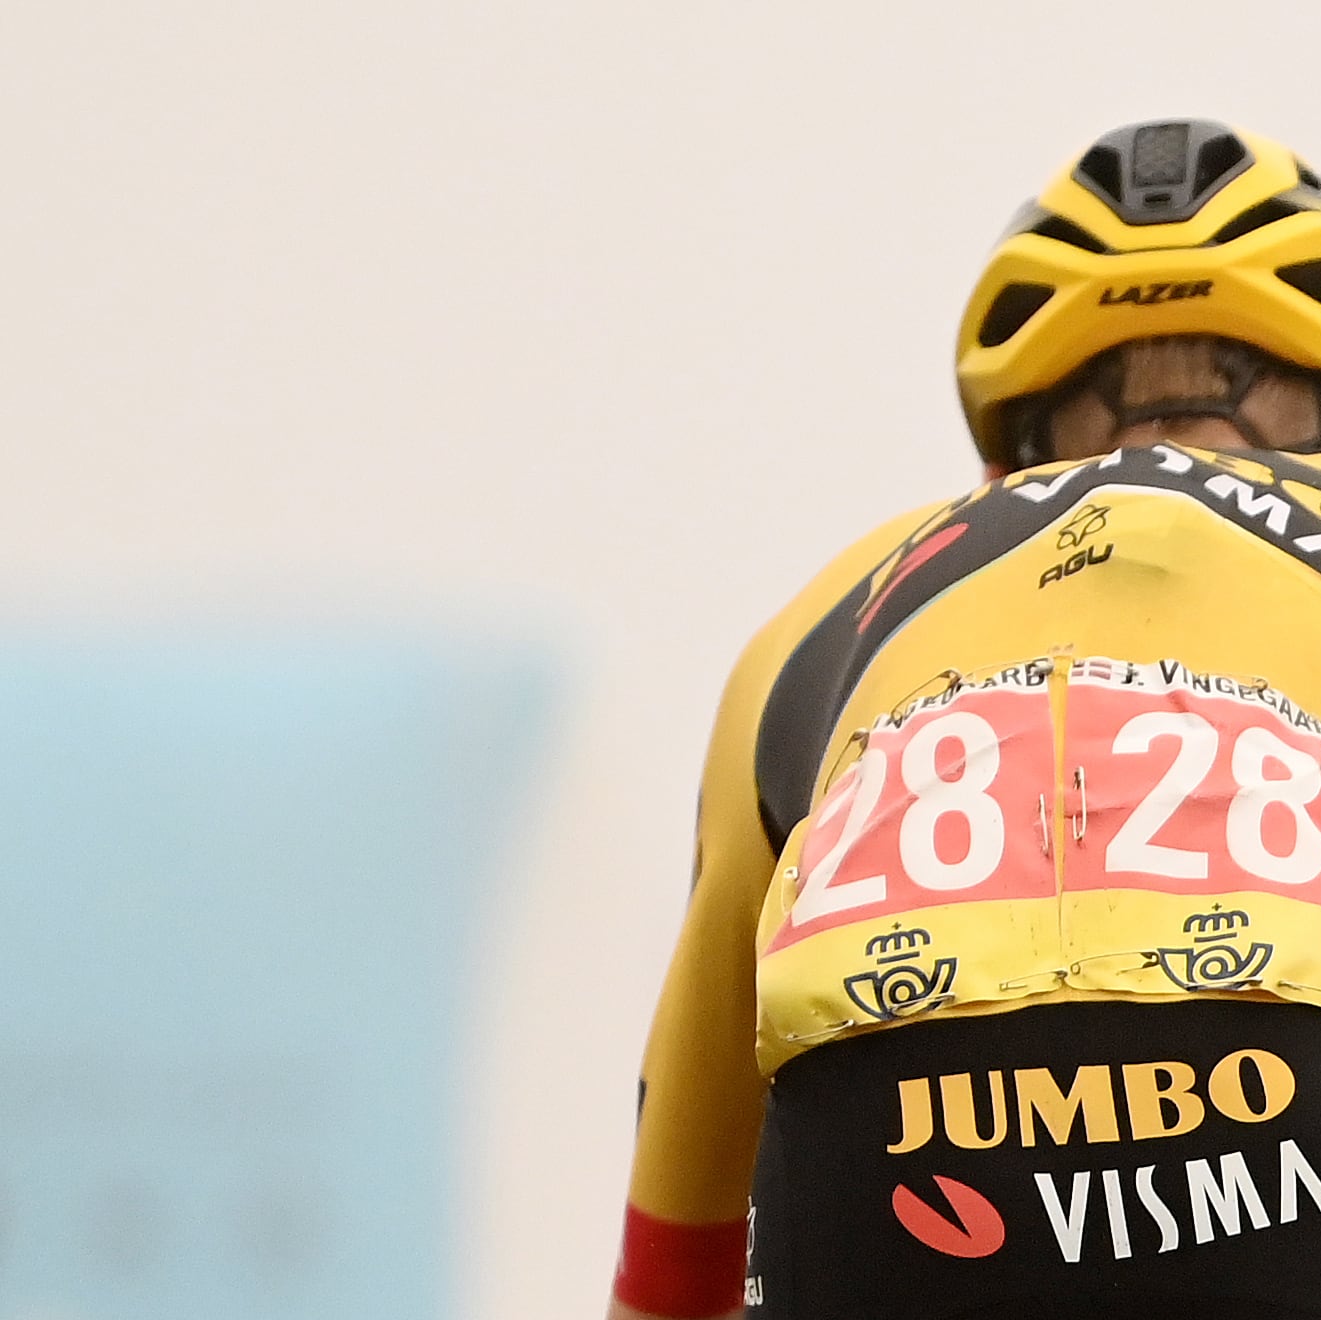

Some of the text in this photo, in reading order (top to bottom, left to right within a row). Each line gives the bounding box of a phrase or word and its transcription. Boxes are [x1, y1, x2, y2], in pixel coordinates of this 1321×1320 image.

[1098, 279, 1214, 306] LAZER
[1038, 543, 1114, 590] AGU
[791, 711, 1005, 928] 28
[887, 1048, 1296, 1154] JUMBO
